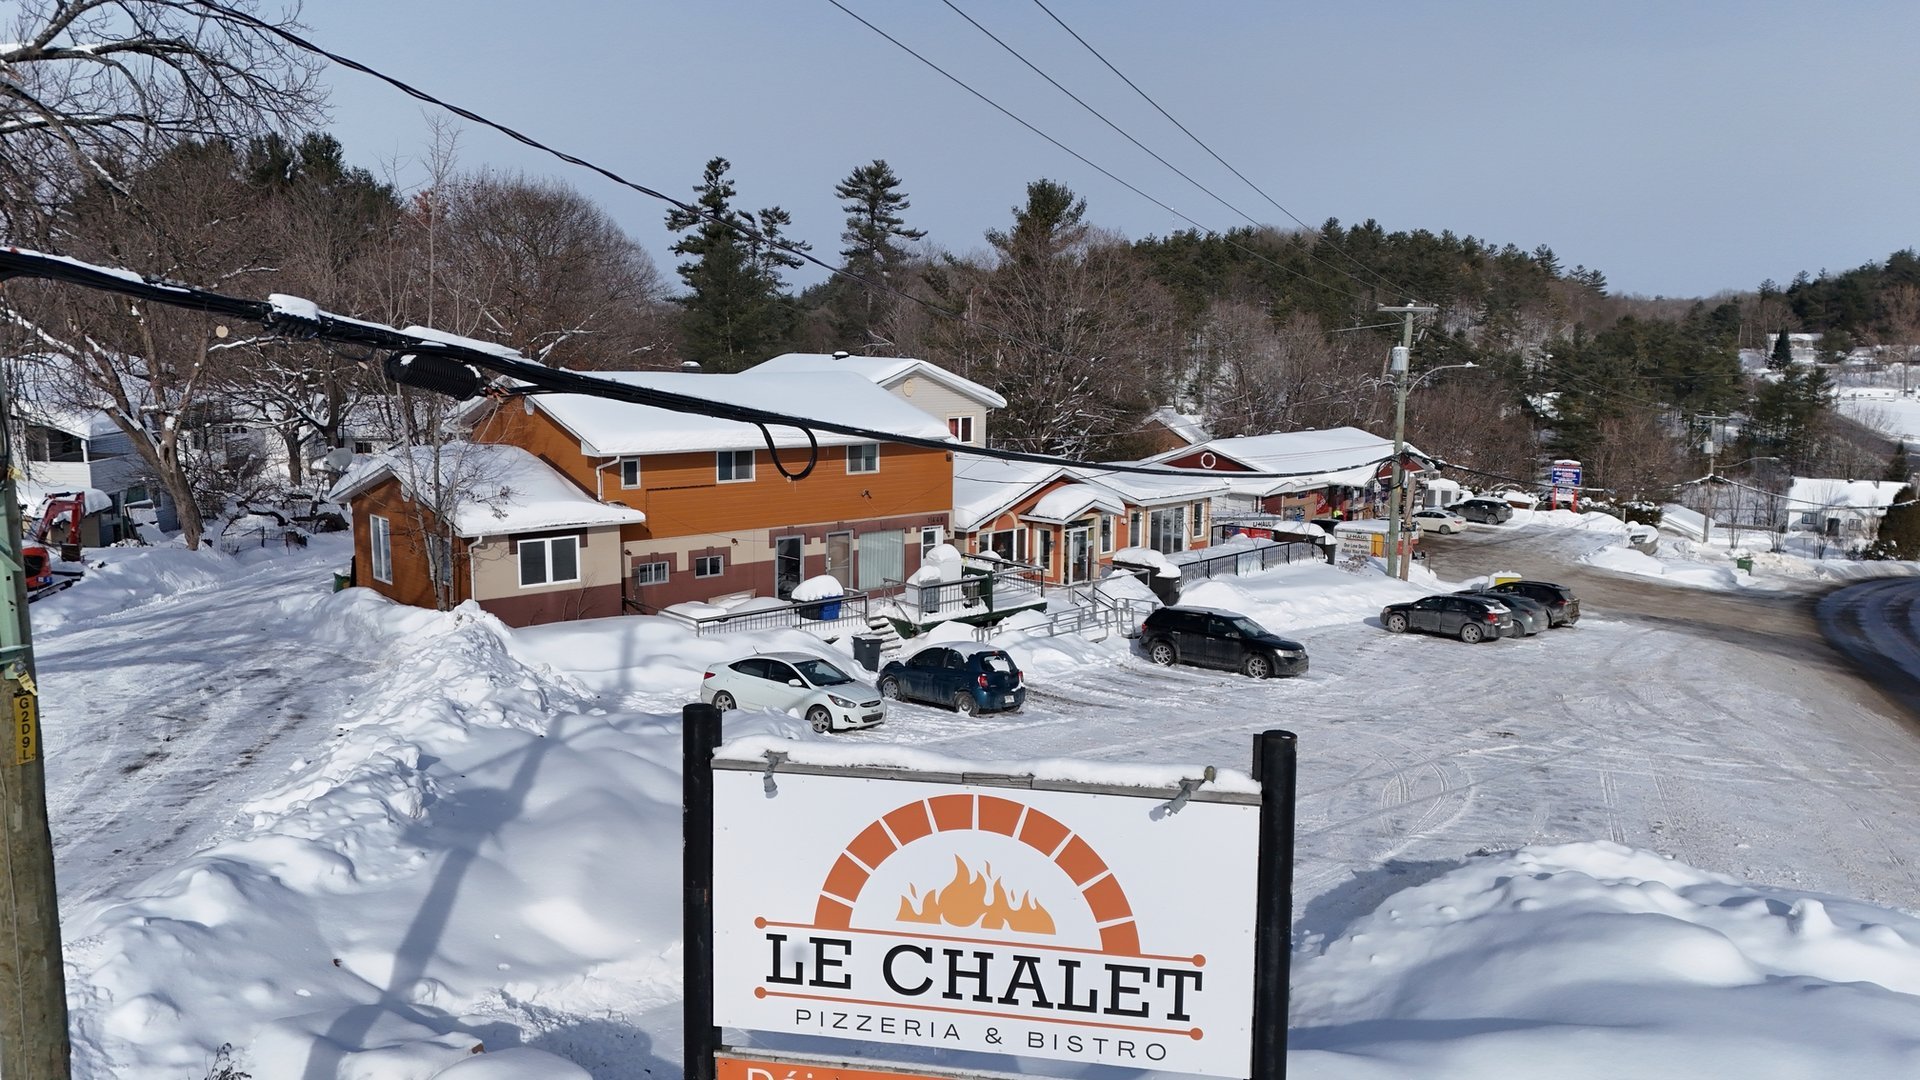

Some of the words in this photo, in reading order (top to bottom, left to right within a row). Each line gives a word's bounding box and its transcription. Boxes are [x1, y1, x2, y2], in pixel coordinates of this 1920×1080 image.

[765, 933, 852, 990] LE
[882, 944, 1203, 1022] CHALET
[795, 1009, 961, 1041] PIZZERIA
[985, 1027, 1003, 1045] &
[1028, 1031, 1167, 1062] BISTRO
